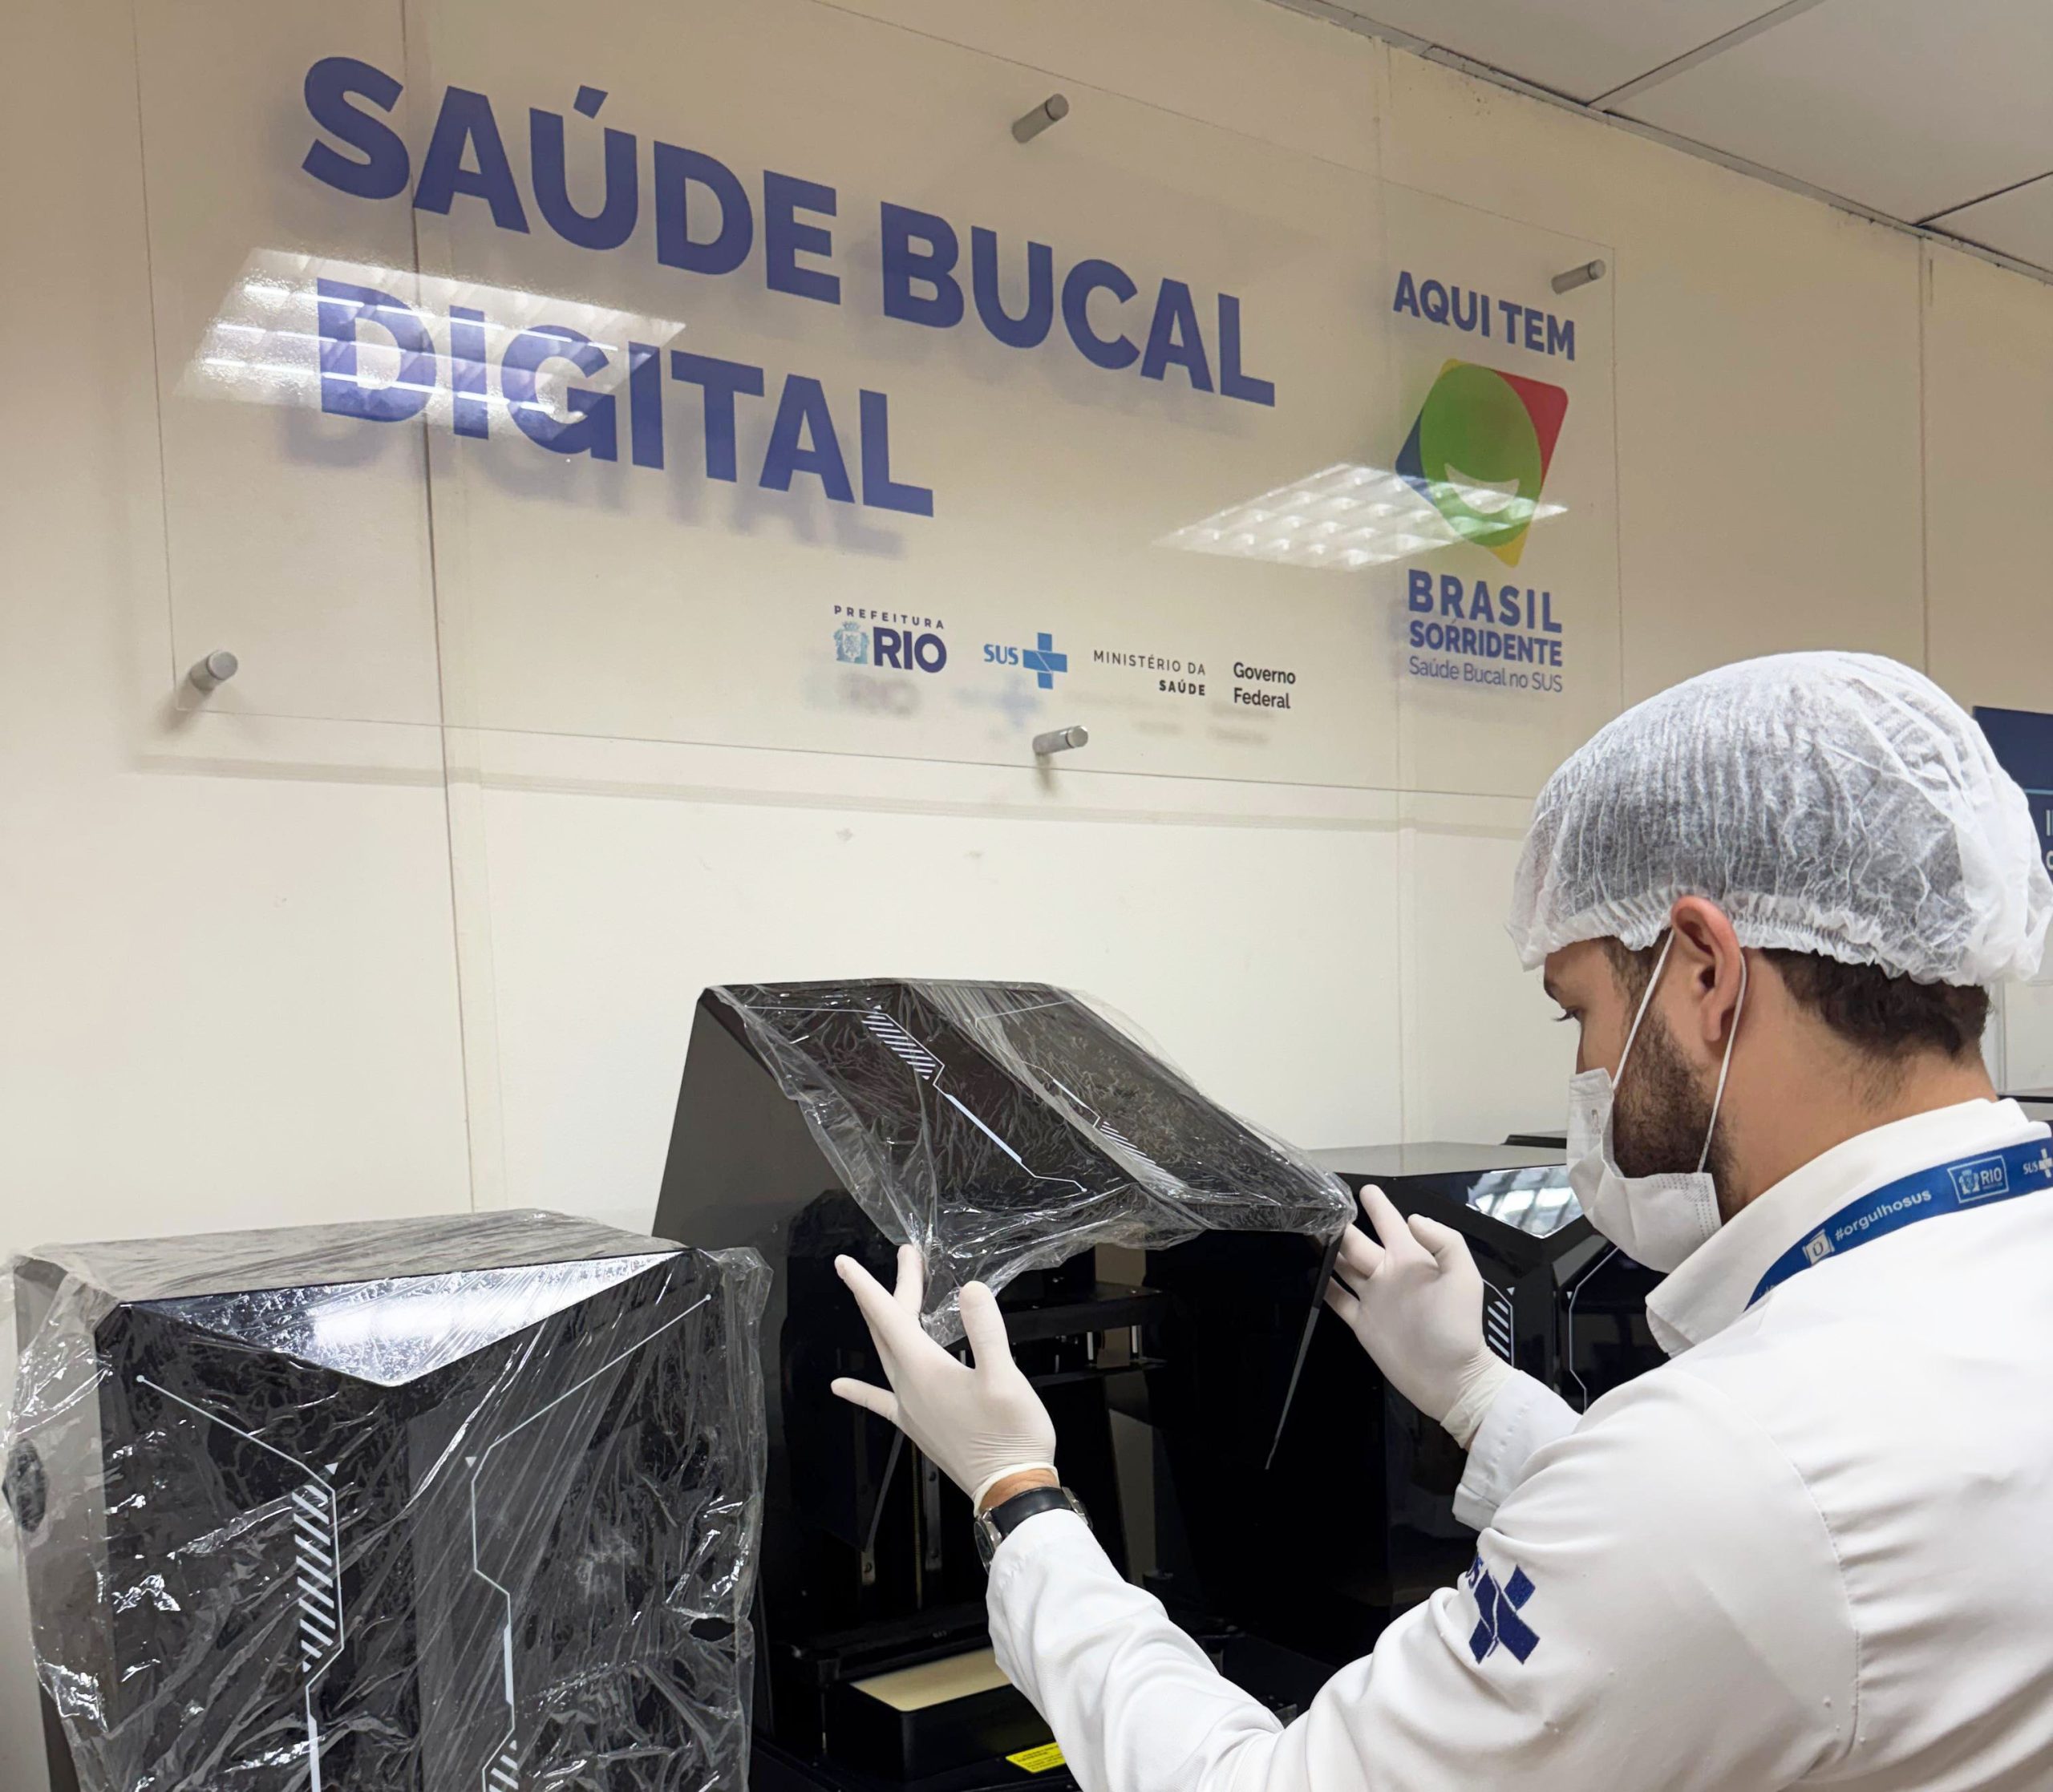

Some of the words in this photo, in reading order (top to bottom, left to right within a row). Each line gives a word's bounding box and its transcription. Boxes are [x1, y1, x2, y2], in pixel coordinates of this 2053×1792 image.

[302, 56, 840, 305] SAÚDE
[881, 201, 1275, 407] BUCAL
[1393, 271, 1490, 338] AQUI
[1499, 301, 1575, 361] TEM
[317, 278, 933, 517] DIGITAL
[834, 605, 944, 629] PREFEITURA
[1408, 569, 1562, 633] BRASIL
[873, 626, 947, 674] RIO
[983, 644, 1019, 665] SUS
[1410, 620, 1563, 667] SORRIDENTE
[1093, 649, 1181, 672] MINISTÉRIO
[1188, 661, 1206, 676] DA
[1233, 661, 1296, 685] Governo
[1409, 655, 1460, 680] Saúde
[1464, 662, 1507, 686] Bucal
[1509, 673, 1529, 689] no
[1532, 672, 1563, 693] SUS
[1159, 679, 1206, 696] SAÚDE
[1233, 687, 1291, 709] Federal
[1980, 1167, 2002, 1186] RIO
[2023, 1160, 2039, 1175] SUS
[1835, 1191, 1933, 1241] #orgulhosus
